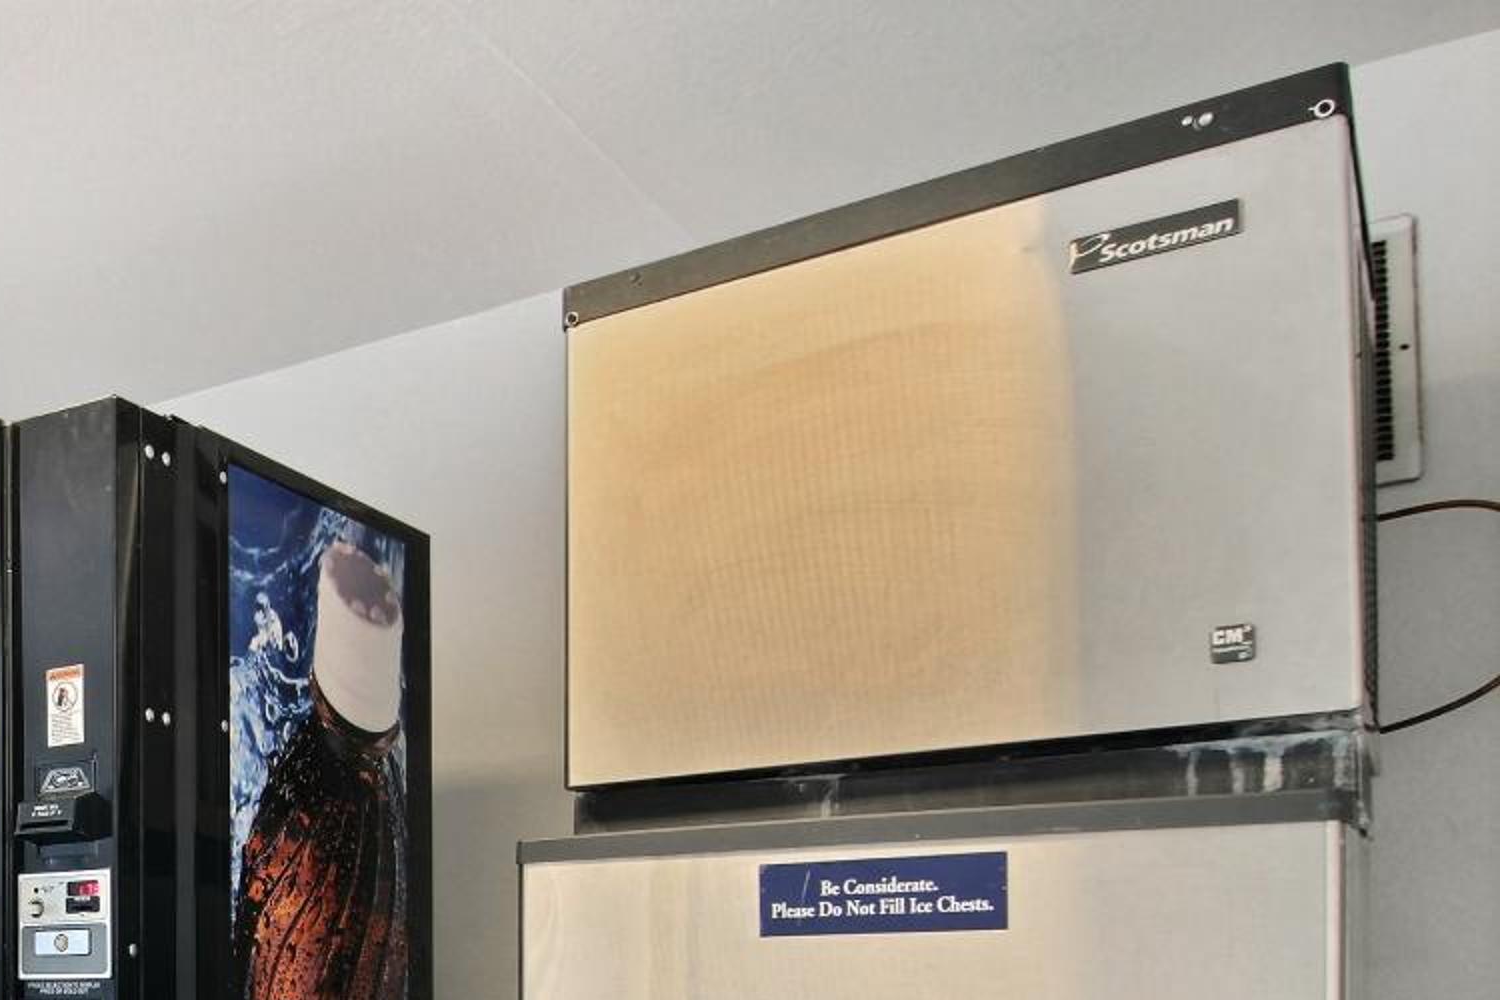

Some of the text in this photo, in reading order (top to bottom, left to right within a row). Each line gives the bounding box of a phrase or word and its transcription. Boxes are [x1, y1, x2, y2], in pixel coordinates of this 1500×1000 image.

[1098, 216, 1235, 263] Scotsman
[820, 876, 939, 897] Be Considerate.
[771, 895, 995, 919] Please Do Not Fill Ice Chests.
